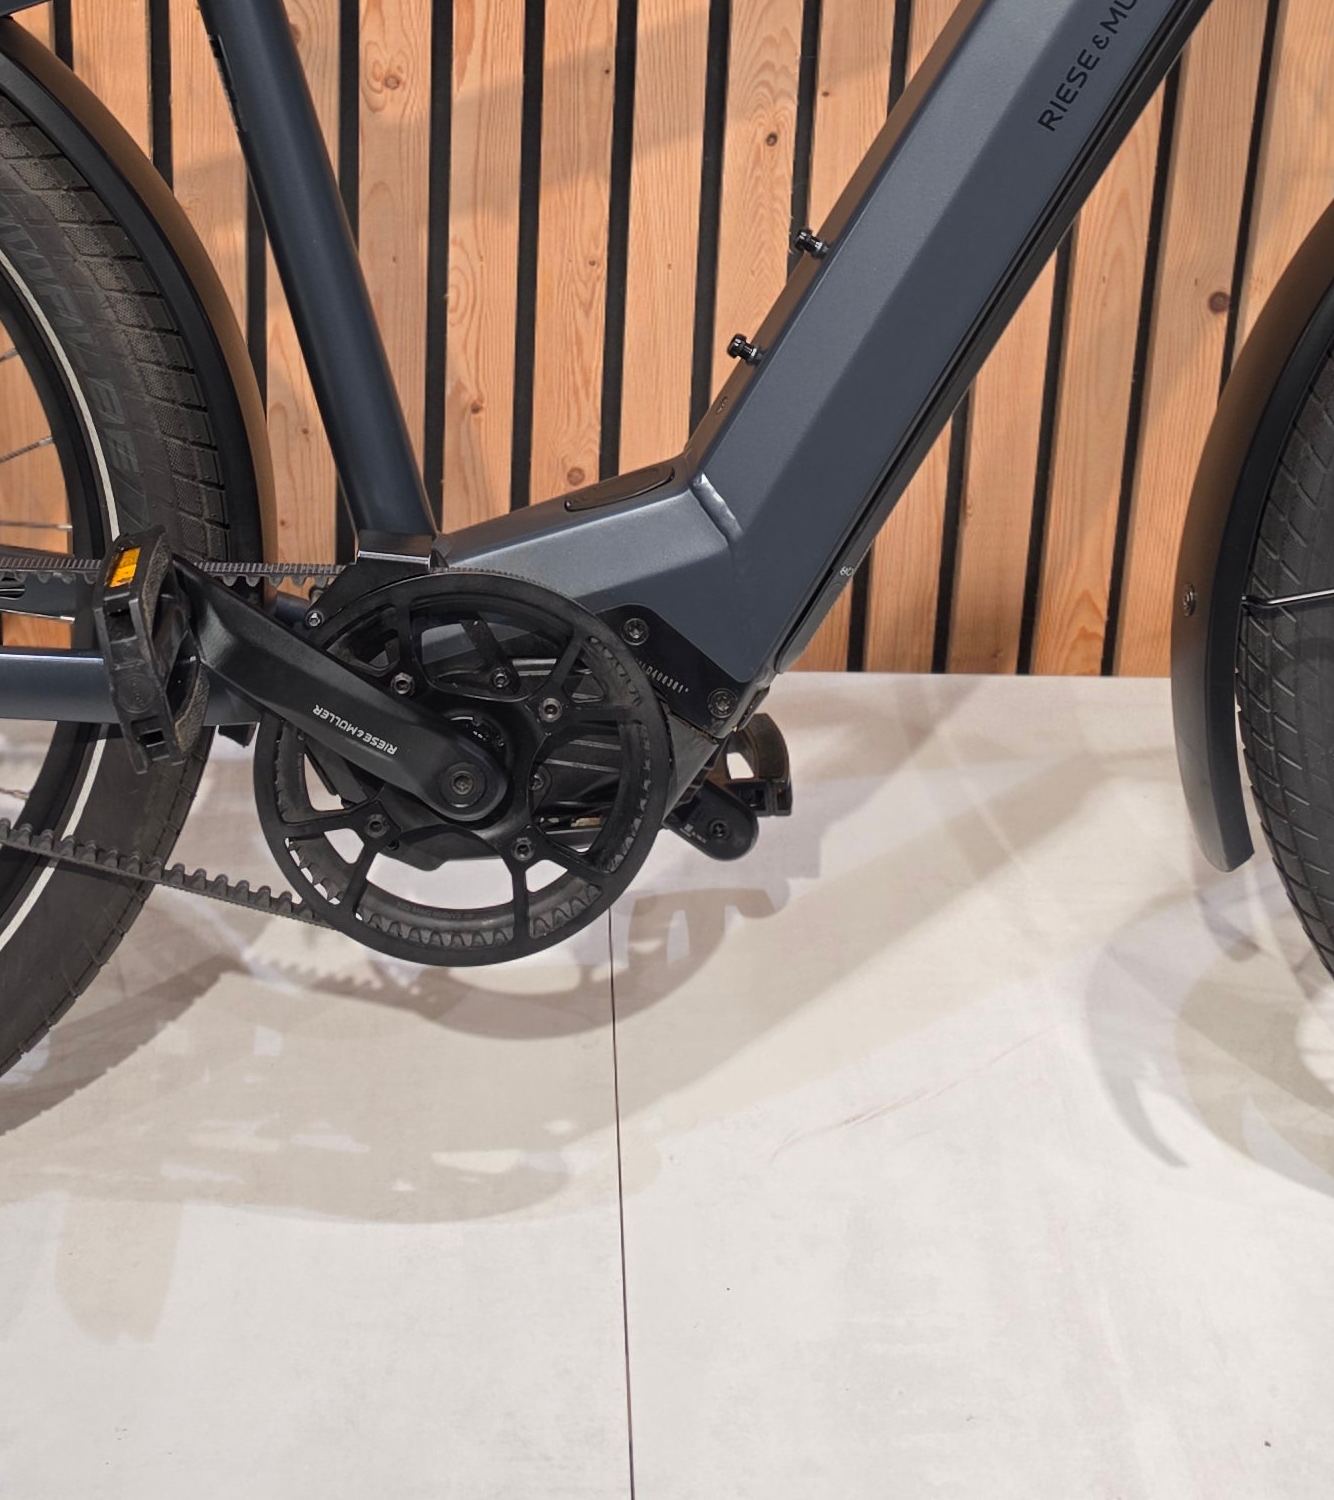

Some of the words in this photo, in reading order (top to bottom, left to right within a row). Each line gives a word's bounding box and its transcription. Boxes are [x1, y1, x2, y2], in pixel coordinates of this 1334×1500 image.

[1036, 49, 1101, 132] RIESE
[311, 704, 360, 736] MÜLLER
[360, 731, 399, 755] RIESE
